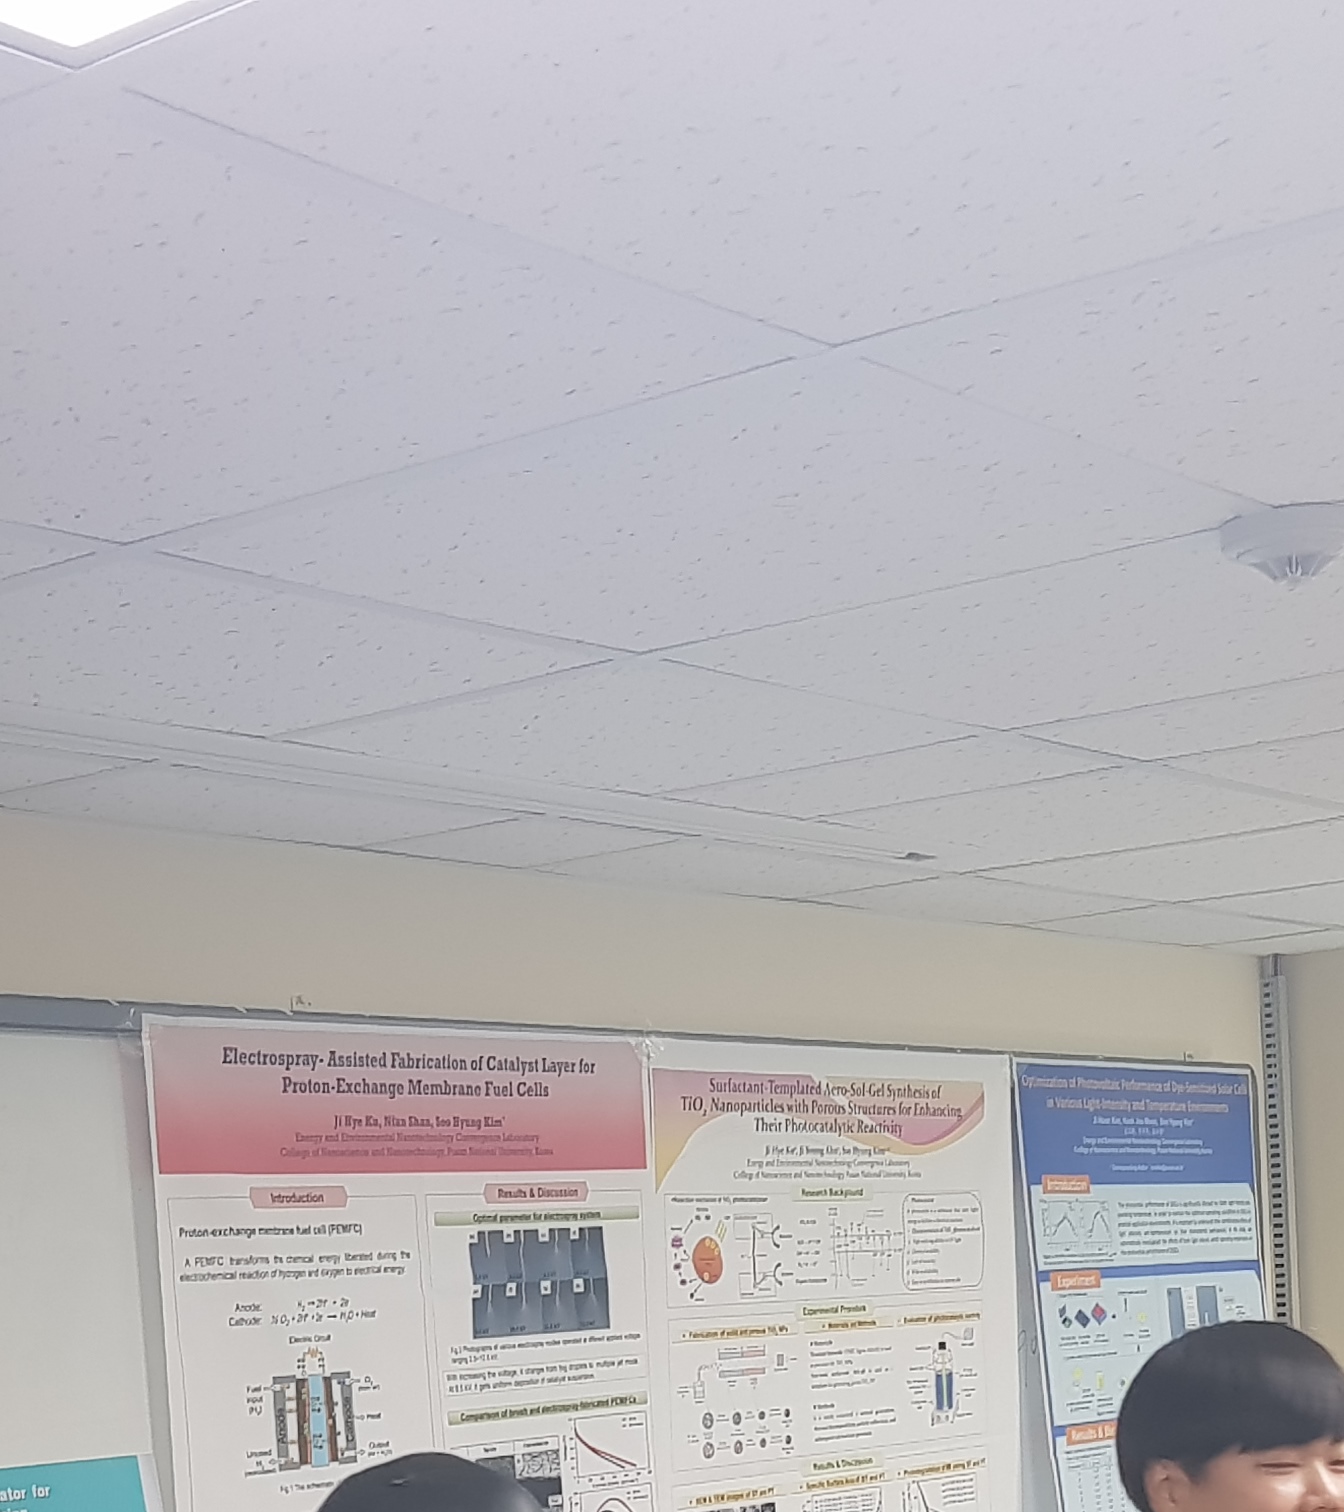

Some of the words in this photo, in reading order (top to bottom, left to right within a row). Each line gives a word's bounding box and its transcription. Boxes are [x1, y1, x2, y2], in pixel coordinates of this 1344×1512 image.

[327, 1050, 386, 1068] Assisted
[390, 1051, 467, 1070] Fabrication
[470, 1055, 483, 1071] of
[486, 1055, 538, 1073] Catalyst
[541, 1057, 575, 1077] Layer
[579, 1057, 595, 1074] for
[282, 1076, 404, 1096] Proton-Exchange
[407, 1078, 481, 1096] Membrane
[484, 1080, 513, 1097] Fuel
[516, 1081, 549, 1097] Cells
[709, 1079, 821, 1096] Surfactant-Templated
[823, 1081, 884, 1098] Aero-Sol-Gel
[886, 1083, 929, 1099] Synthesis
[931, 1084, 940, 1099] of
[710, 1096, 784, 1113] Nanoparticles
[786, 1100, 808, 1113] with
[811, 1099, 846, 1115] Porous
[848, 1102, 896, 1116] Structures
[898, 1100, 911, 1116] for
[913, 1102, 961, 1120] Enhancing
[755, 1119, 782, 1132] Their
[785, 1120, 855, 1137] Photocatalytic
[856, 1118, 902, 1138] Reactivity
[270, 1191, 324, 1203] Introduction
[497, 1187, 527, 1198] Results
[529, 1187, 535, 1198] &
[537, 1186, 578, 1198] Discussion
[1057, 1272, 1096, 1288] Experiment
[30, 1483, 50, 1498] for
